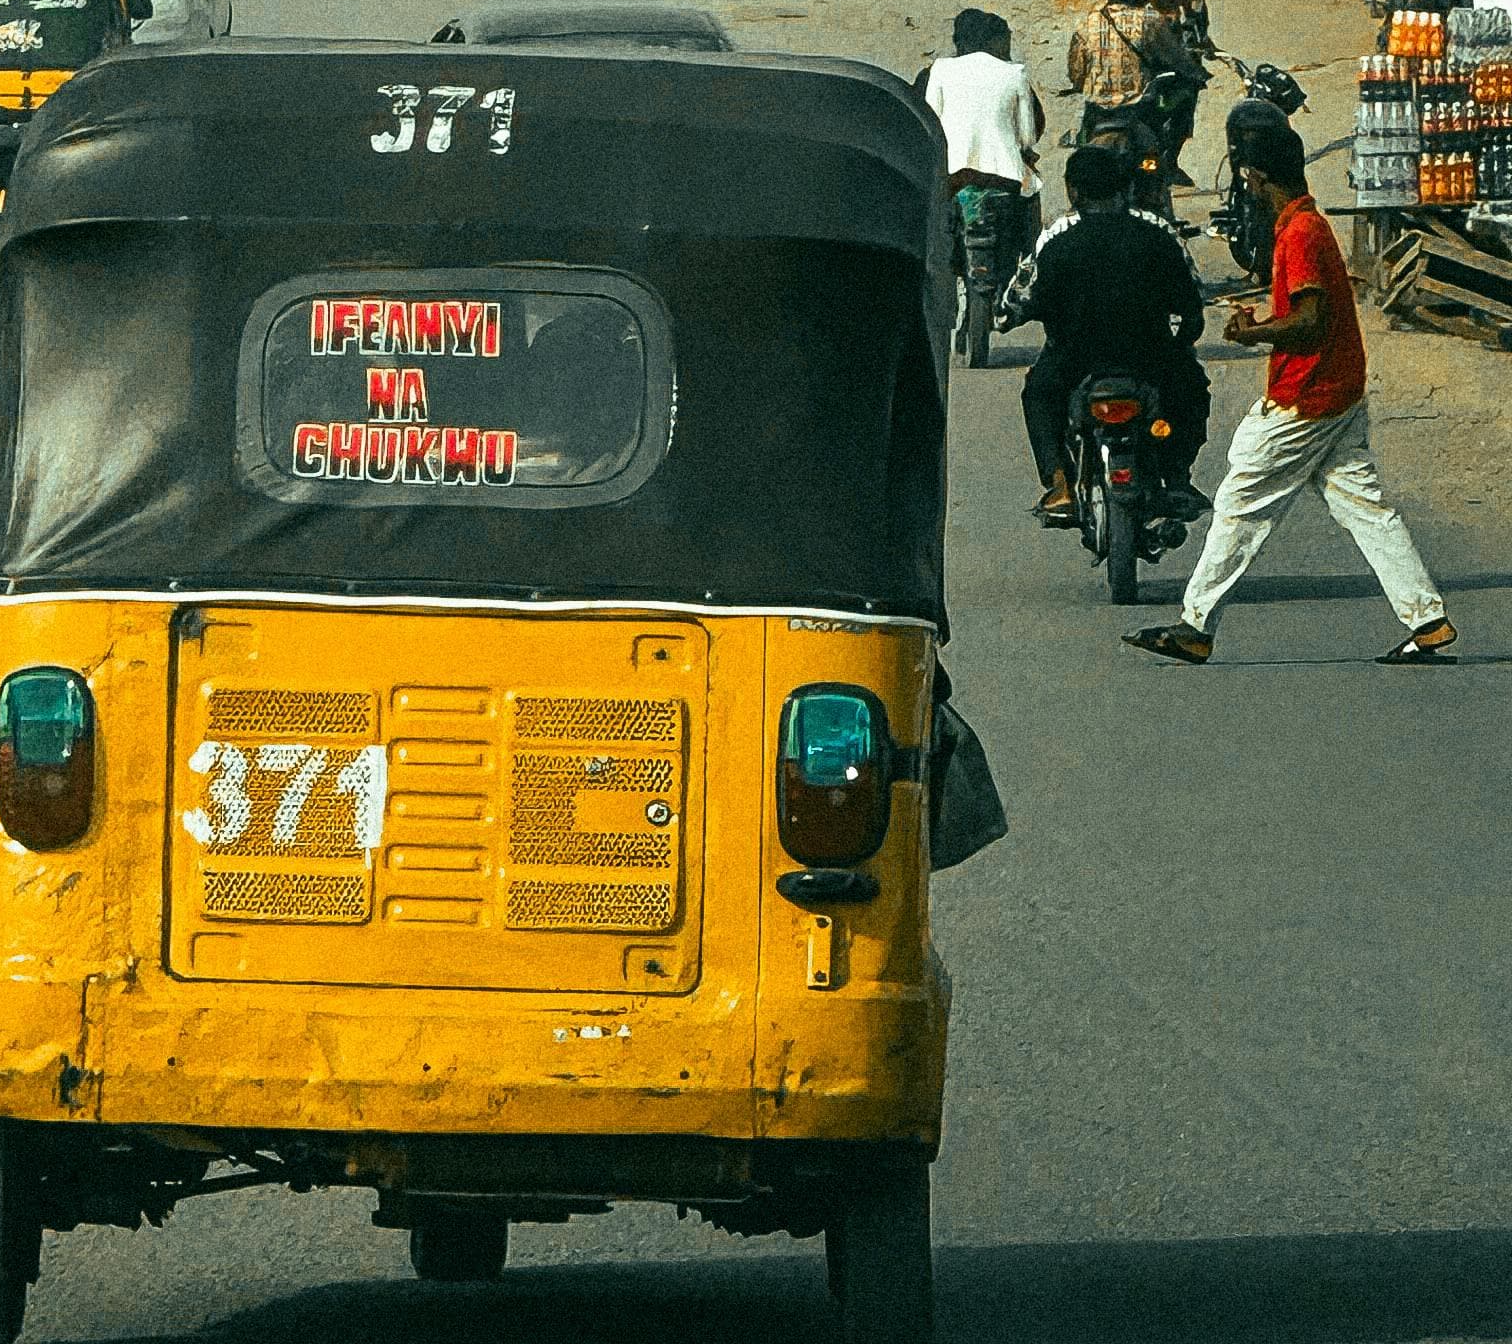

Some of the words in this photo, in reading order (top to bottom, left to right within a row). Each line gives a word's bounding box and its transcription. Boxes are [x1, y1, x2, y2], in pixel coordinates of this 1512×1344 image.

[370, 84, 516, 155] 371
[310, 299, 501, 357] IFEANYI
[365, 367, 429, 422] NA
[292, 422, 518, 487] CHUKWU
[182, 740, 388, 850] 371
